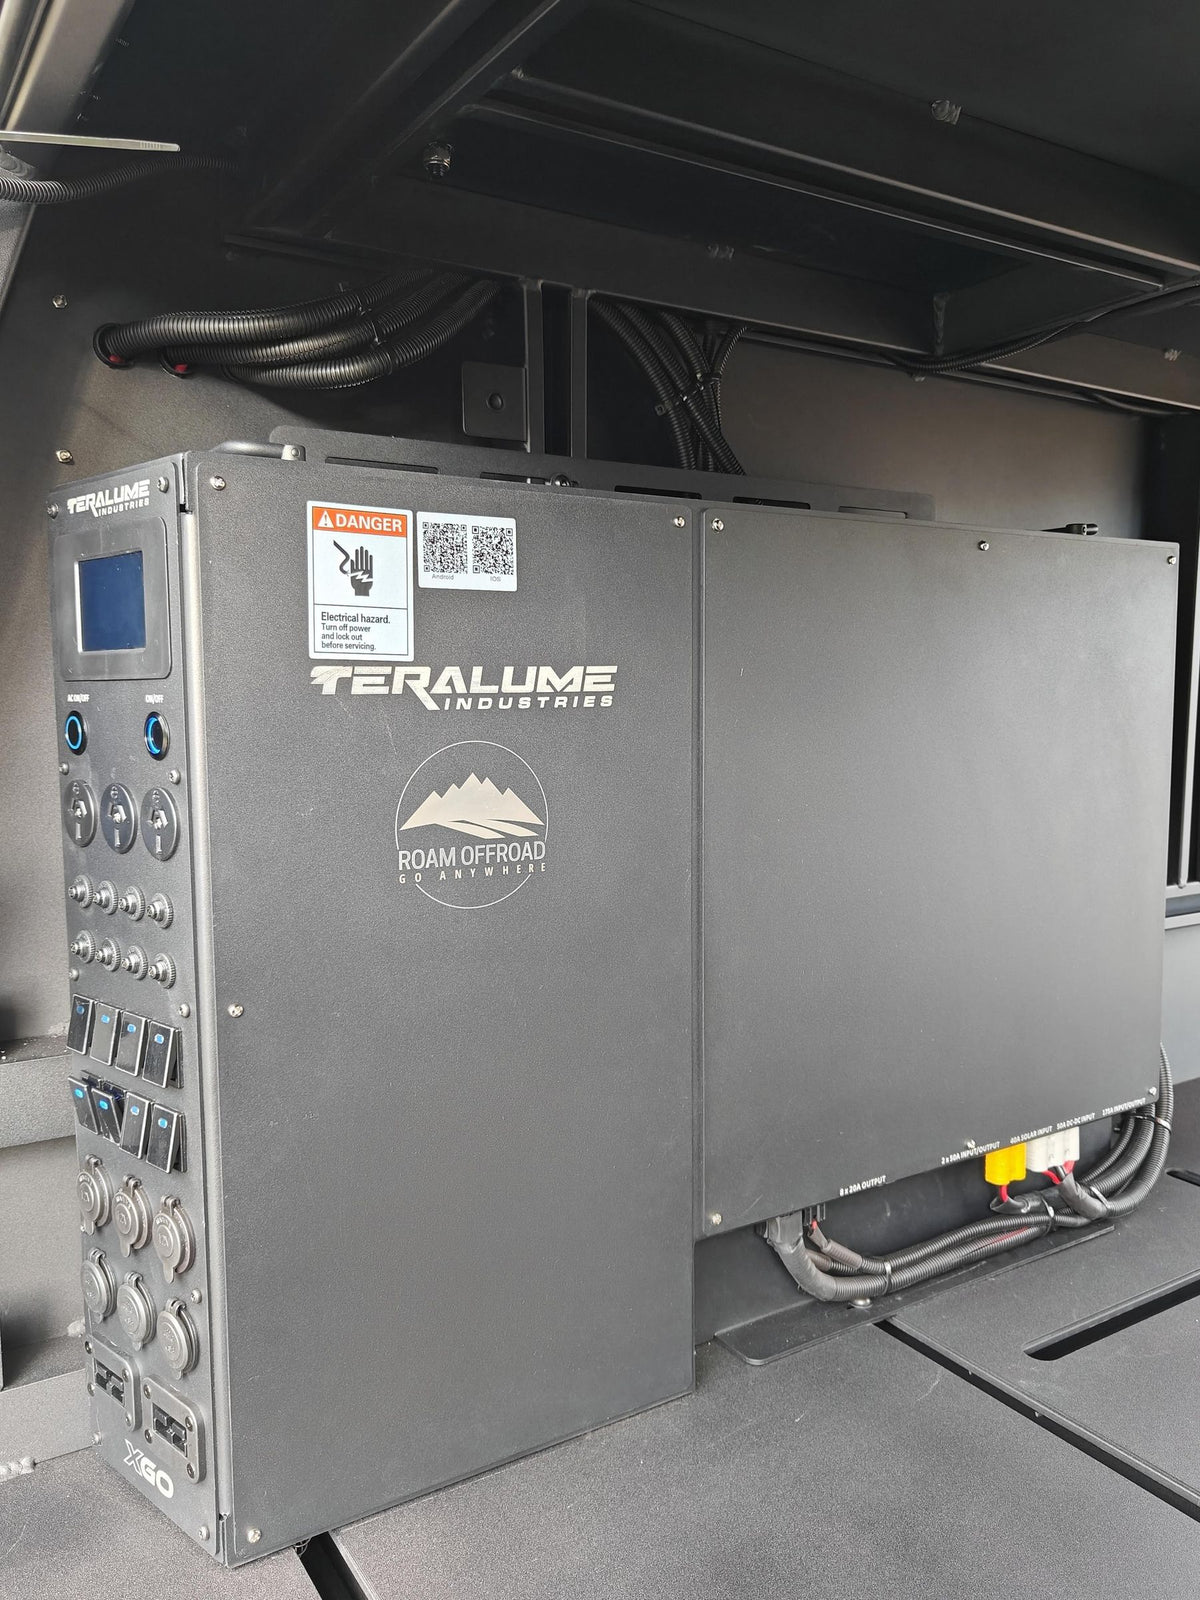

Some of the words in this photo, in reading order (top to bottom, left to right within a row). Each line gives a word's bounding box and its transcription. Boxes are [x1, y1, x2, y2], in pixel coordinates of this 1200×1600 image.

[67, 479, 150, 517] TERALUME
[98, 497, 150, 516] INDUSTRIES
[335, 513, 403, 533] DANGER
[431, 573, 455, 581] Android
[321, 611, 359, 622] Electrical
[360, 613, 391, 624] hazard.
[321, 623, 337, 631] Turn
[338, 623, 348, 631] off
[349, 625, 371, 634] power
[321, 632, 335, 640] and
[336, 632, 350, 640] lock
[351, 633, 363, 641] out
[321, 641, 343, 649] before
[344, 642, 376, 651] servicing.
[310, 665, 618, 711] TERALUME
[74, 694, 90, 704] ON/OFF
[145, 694, 164, 705] ON/OFF
[444, 695, 613, 711] INDUSTRIES
[398, 848, 456, 871] ROAM
[460, 840, 546, 866] OFFROAD
[399, 872, 422, 884] GO
[439, 862, 546, 881] ANYWHERE
[1114, 1097, 1146, 1113] INPUT/OUTPUT
[1056, 1121, 1067, 1131] 50A
[1067, 1117, 1081, 1128] DC-DC
[1080, 1112, 1096, 1123] INPUT
[1010, 1134, 1021, 1145] 40A
[1020, 1130, 1037, 1142] SOLAR
[1037, 1125, 1053, 1137] INPUT
[949, 1152, 961, 1163] 50A
[960, 1141, 1000, 1159] INPUT/OUTPUT
[839, 1187, 845, 1197] 8
[849, 1183, 862, 1193] 20A
[861, 1175, 887, 1189] OUTPUT
[123, 1438, 174, 1499] XGO
